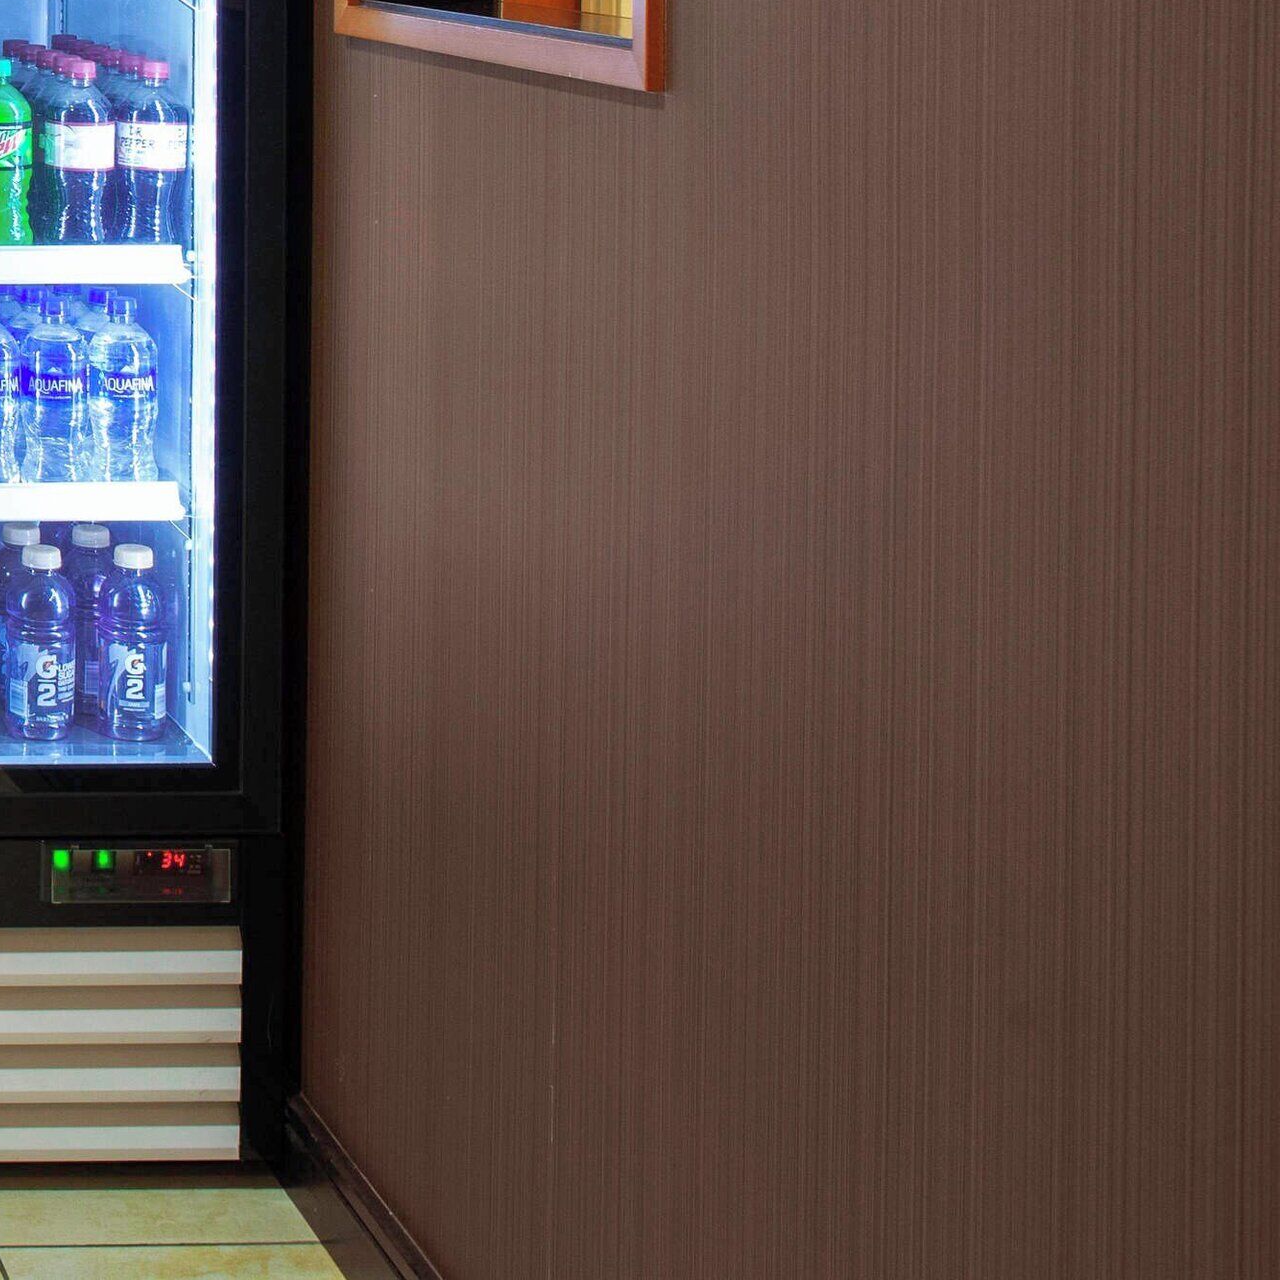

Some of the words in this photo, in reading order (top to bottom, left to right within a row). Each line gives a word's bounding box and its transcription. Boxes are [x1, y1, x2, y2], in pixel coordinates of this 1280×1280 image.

[29, 378, 82, 394] AQUAFINA
[103, 377, 154, 393] AQUAFINA
[161, 851, 186, 868] 34
